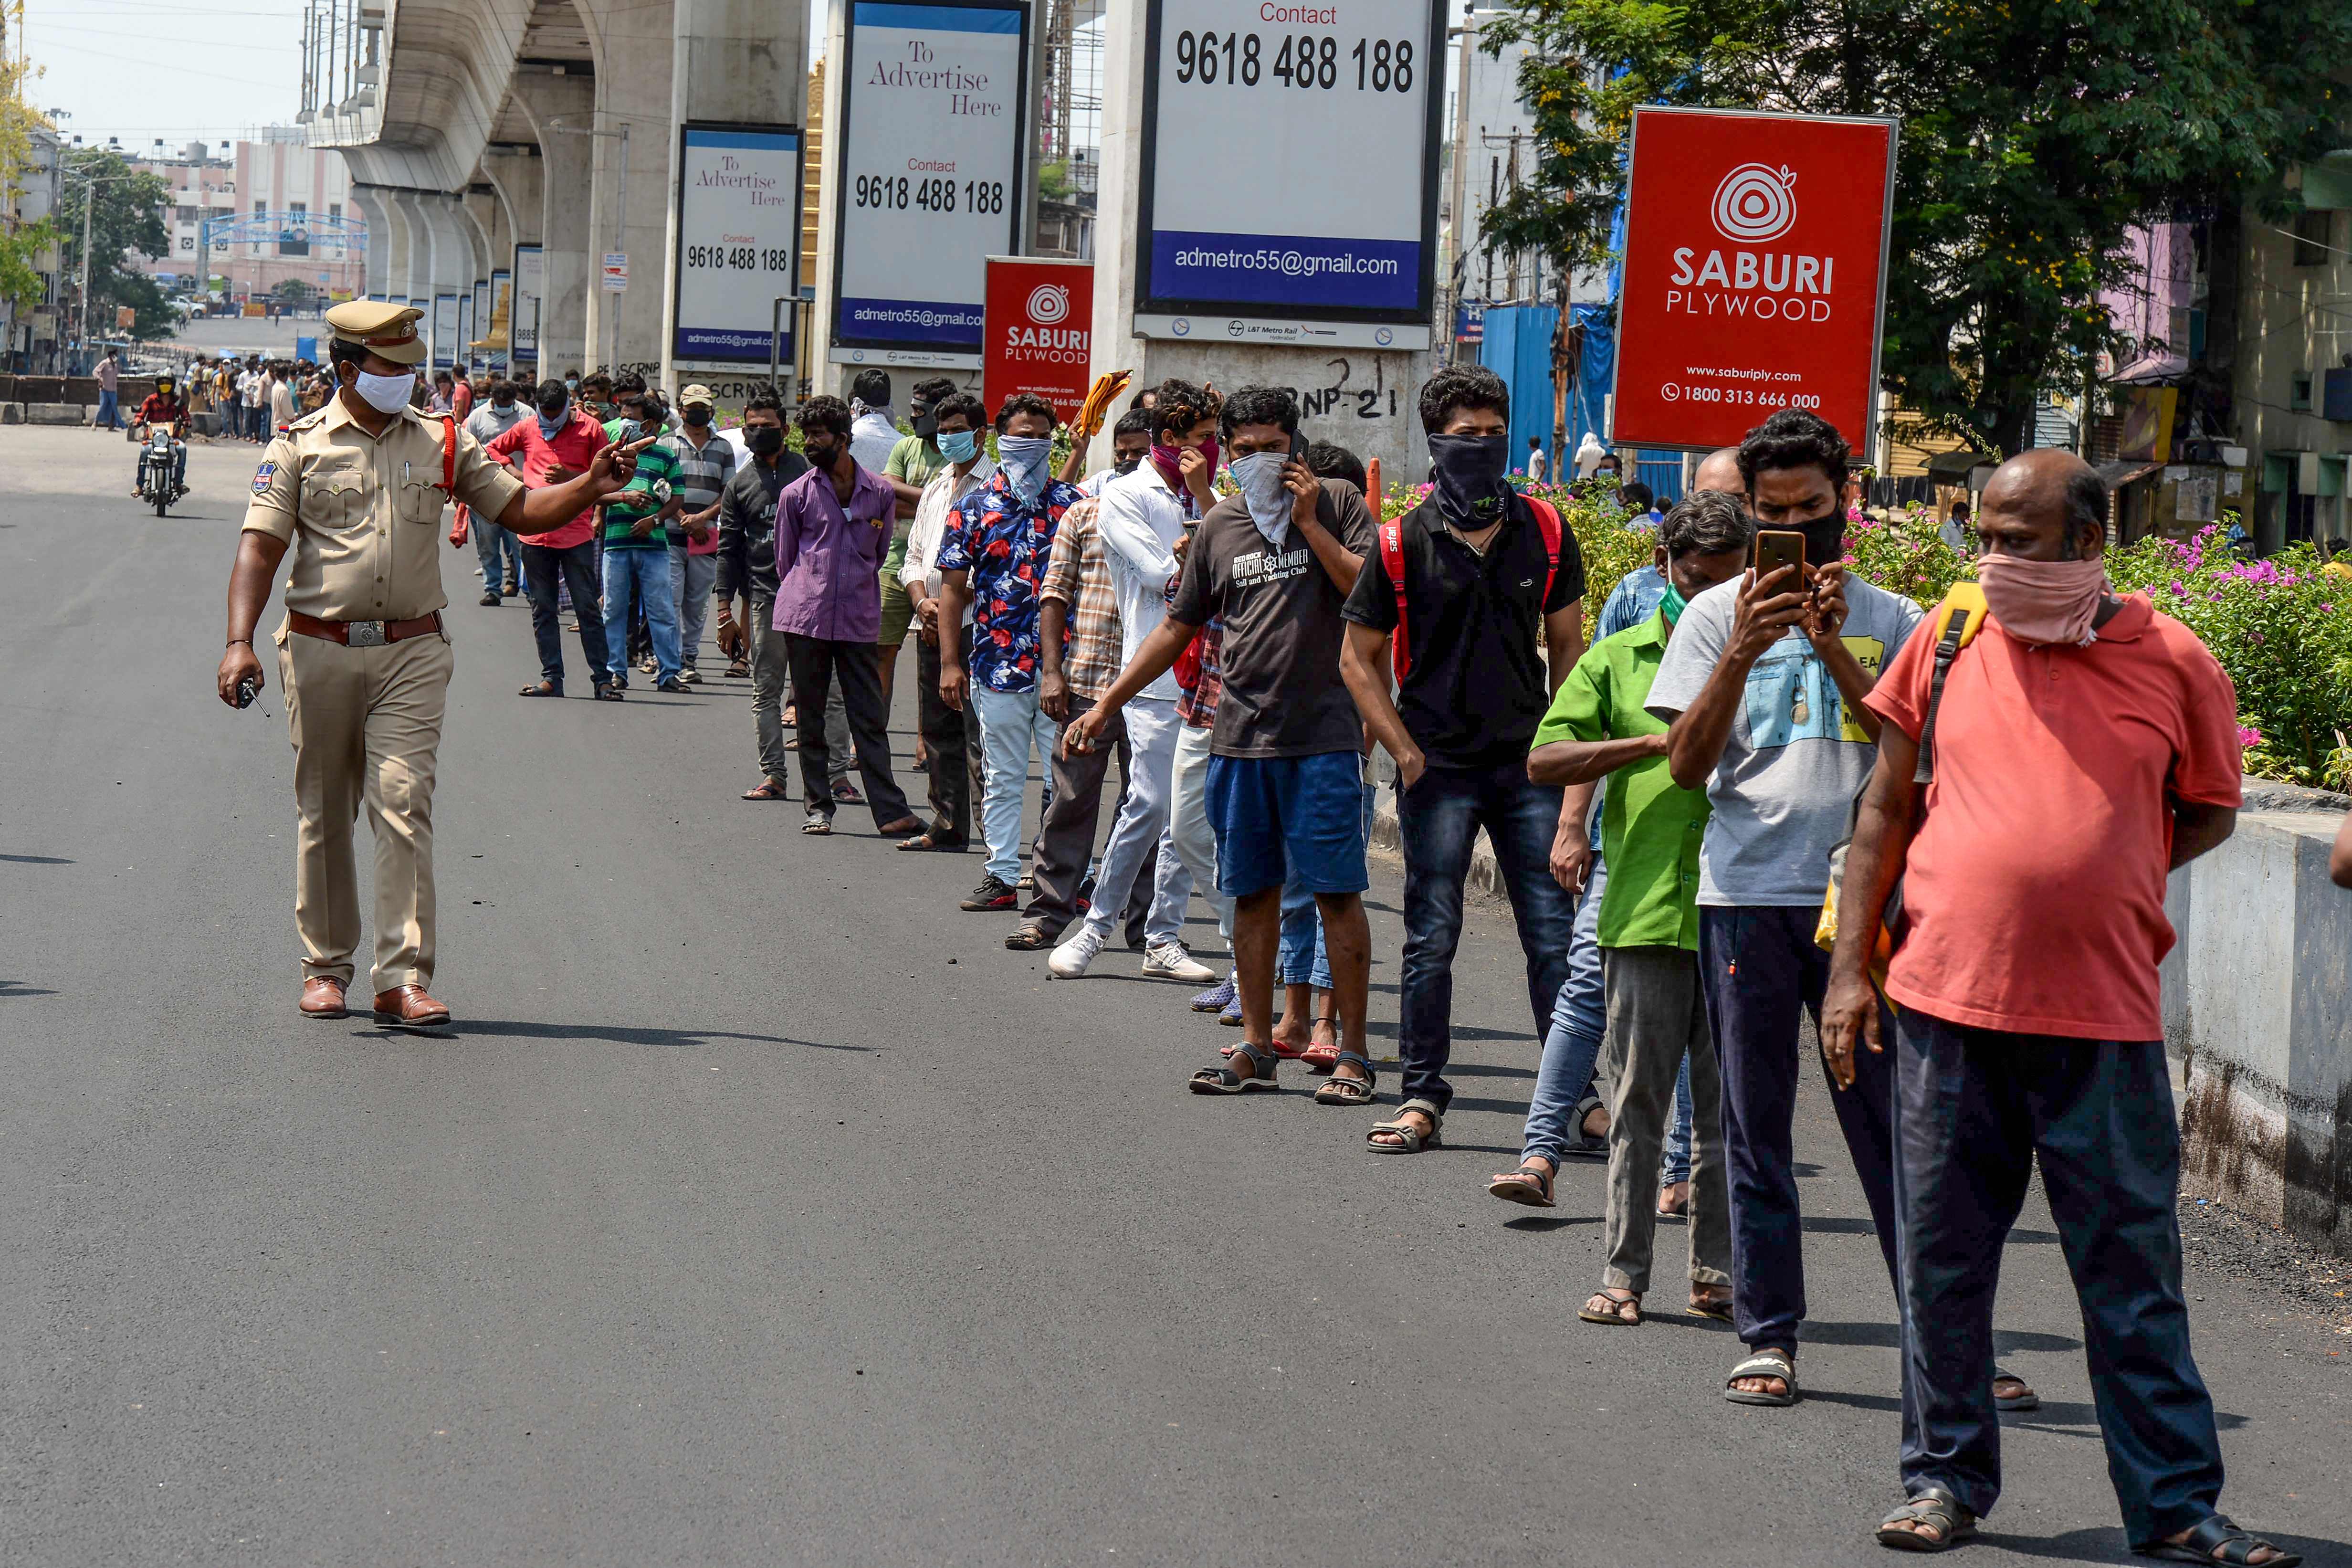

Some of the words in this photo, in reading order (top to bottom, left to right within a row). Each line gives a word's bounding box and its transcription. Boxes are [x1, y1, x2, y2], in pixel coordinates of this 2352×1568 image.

[1260, 2, 1336, 24] Contact
[908, 41, 933, 63] To
[1176, 30, 1260, 86] 9618
[1273, 34, 1336, 90] 488
[1353, 38, 1413, 93] 188
[868, 61, 988, 91] Advertise
[950, 94, 1001, 116] Here
[722, 156, 739, 171] To
[908, 158, 956, 172] Contact
[696, 169, 776, 189] Advertise
[751, 191, 785, 206] Here
[856, 175, 909, 210] 9618
[916, 178, 955, 212] 488
[965, 181, 1003, 214] 188
[723, 234, 755, 243] Contact
[688, 246, 723, 268] 9618
[729, 247, 755, 270] 488
[761, 249, 787, 271] 188
[1175, 247, 1398, 277] admetro55@gmail.com
[1670, 247, 1833, 295] SABURI
[1667, 290, 1831, 322] PLYWOOD
[688, 335, 781, 347] admetro55@gmail.co
[1008, 326, 1088, 350] SABURI
[1005, 347, 1088, 364] PLYWOOD
[1686, 367, 1801, 382] www.saburiply.com
[1017, 385, 1075, 394] www.saburiply.com
[1684, 387, 1721, 402] 1800
[1725, 389, 1754, 404] 313
[1758, 392, 1786, 407] 666
[1791, 394, 1820, 409] 000
[1386, 526, 1398, 552] safari
[1232, 558, 1264, 579] OFFICIAL
[1278, 548, 1308, 569] MEMBER
[1246, 551, 1262, 561] ROCK
[1236, 579, 1247, 588] Sail
[1249, 575, 1261, 585] and
[1262, 570, 1289, 583] Yachting
[1291, 566, 1307, 576] Club
